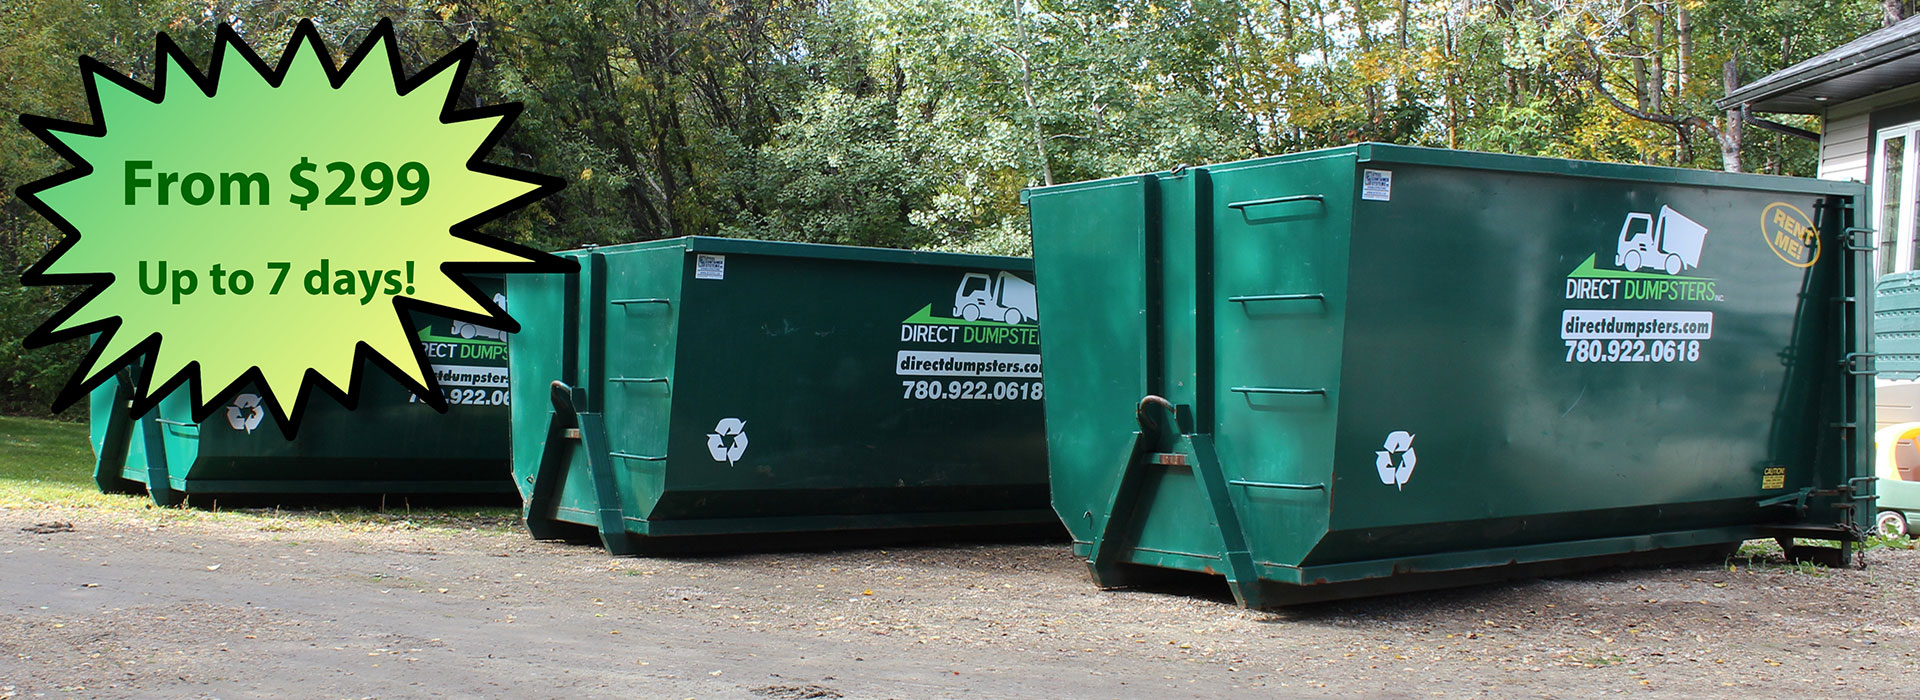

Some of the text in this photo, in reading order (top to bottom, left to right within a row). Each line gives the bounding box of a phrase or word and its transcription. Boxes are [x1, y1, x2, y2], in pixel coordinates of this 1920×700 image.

[1773, 208, 1814, 246] RENT
[1774, 230, 1803, 260] ME!
[1566, 279, 1620, 299] DIRECT
[1624, 280, 1716, 301] DUMPSTERS
[900, 324, 1040, 345] DIRECT DUMPSTE
[1565, 316, 1709, 338] directdumpsters.com
[460, 344, 508, 360] DUMPS
[1565, 340, 1700, 363] 780.922.0618
[900, 355, 1041, 375] directdumpsters.co
[902, 380, 1043, 400] 780.922.0618
